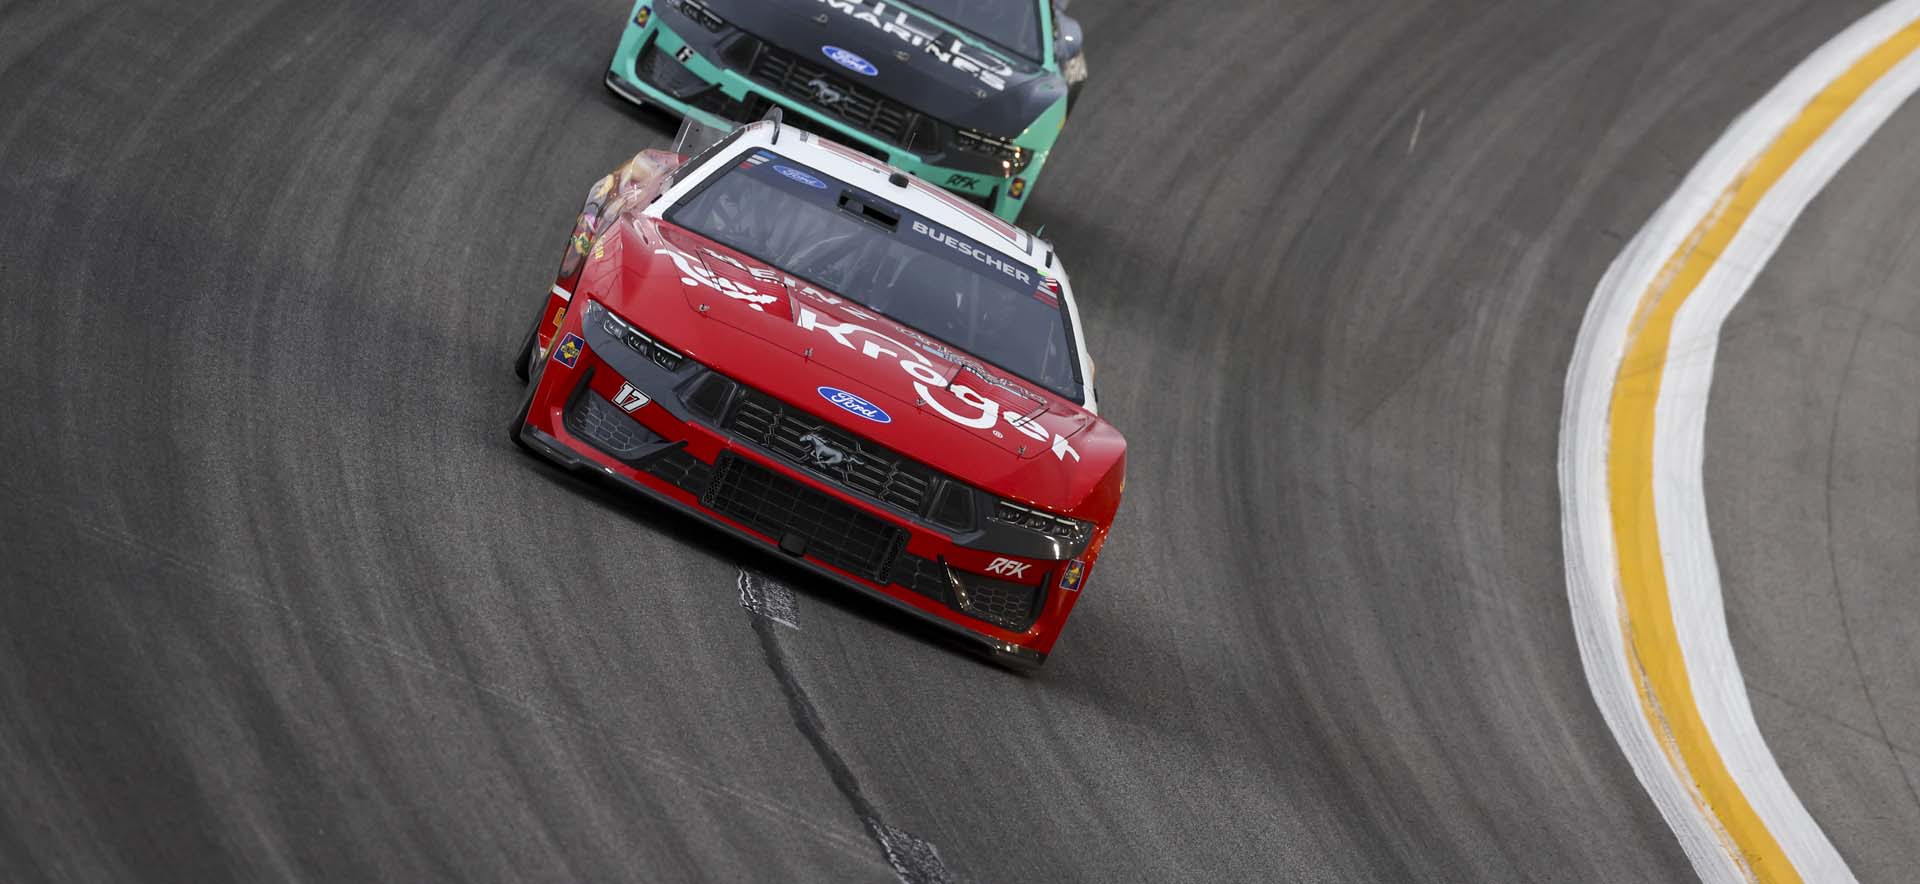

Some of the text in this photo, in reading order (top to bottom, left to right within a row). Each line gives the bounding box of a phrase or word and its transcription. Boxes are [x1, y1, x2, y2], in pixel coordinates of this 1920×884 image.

[818, 0, 1005, 91] MARINES
[842, 0, 1013, 76] ILD
[674, 44, 695, 63] 6
[828, 48, 871, 74] Ford
[779, 167, 822, 187] Ford
[945, 174, 980, 190] RFK
[912, 221, 1031, 286] BUESCHER
[612, 381, 651, 413] 17
[797, 307, 1081, 463] Kroger
[827, 390, 881, 420] Ford
[985, 557, 1031, 579] RFK
